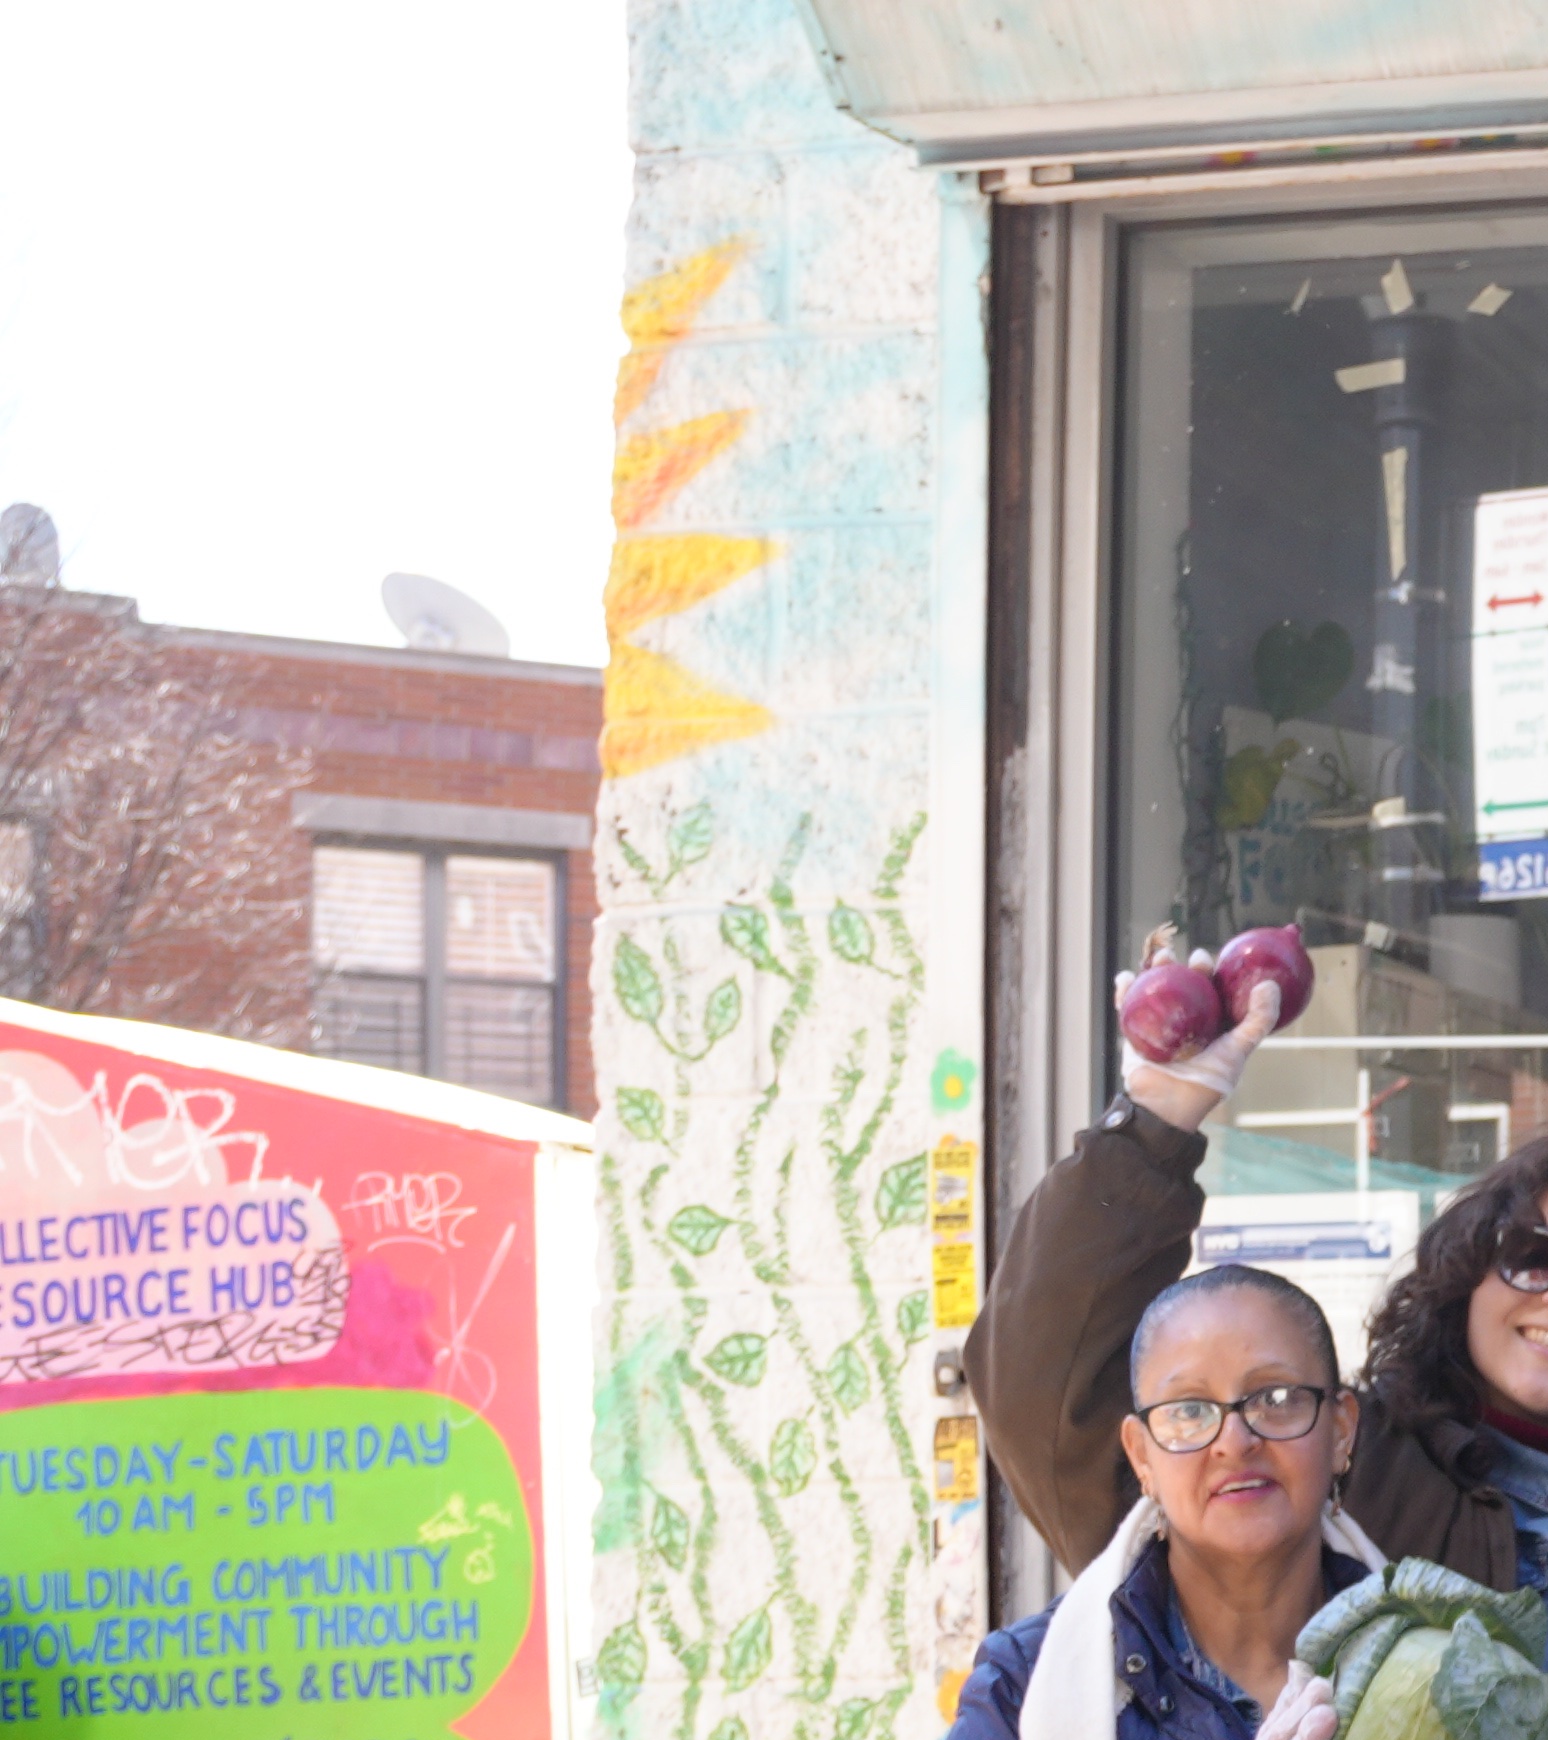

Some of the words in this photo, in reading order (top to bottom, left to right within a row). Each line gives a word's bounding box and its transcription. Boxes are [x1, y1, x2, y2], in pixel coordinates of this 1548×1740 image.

[0, 1207, 172, 1265] LLECTIVE
[183, 1198, 309, 1250] FOCUS
[0, 1268, 191, 1329] SOURCE
[208, 1261, 296, 1314] HUB
[249, 1482, 335, 1527] 5PM
[213, 1545, 452, 1600] COMMUNITY
[289, 1600, 480, 1650] THROUGH
[0, 1679, 42, 1723] EE
[60, 1666, 282, 1720] RESOURCES
[299, 1668, 321, 1700] &
[332, 1654, 475, 1702] EVENTS
